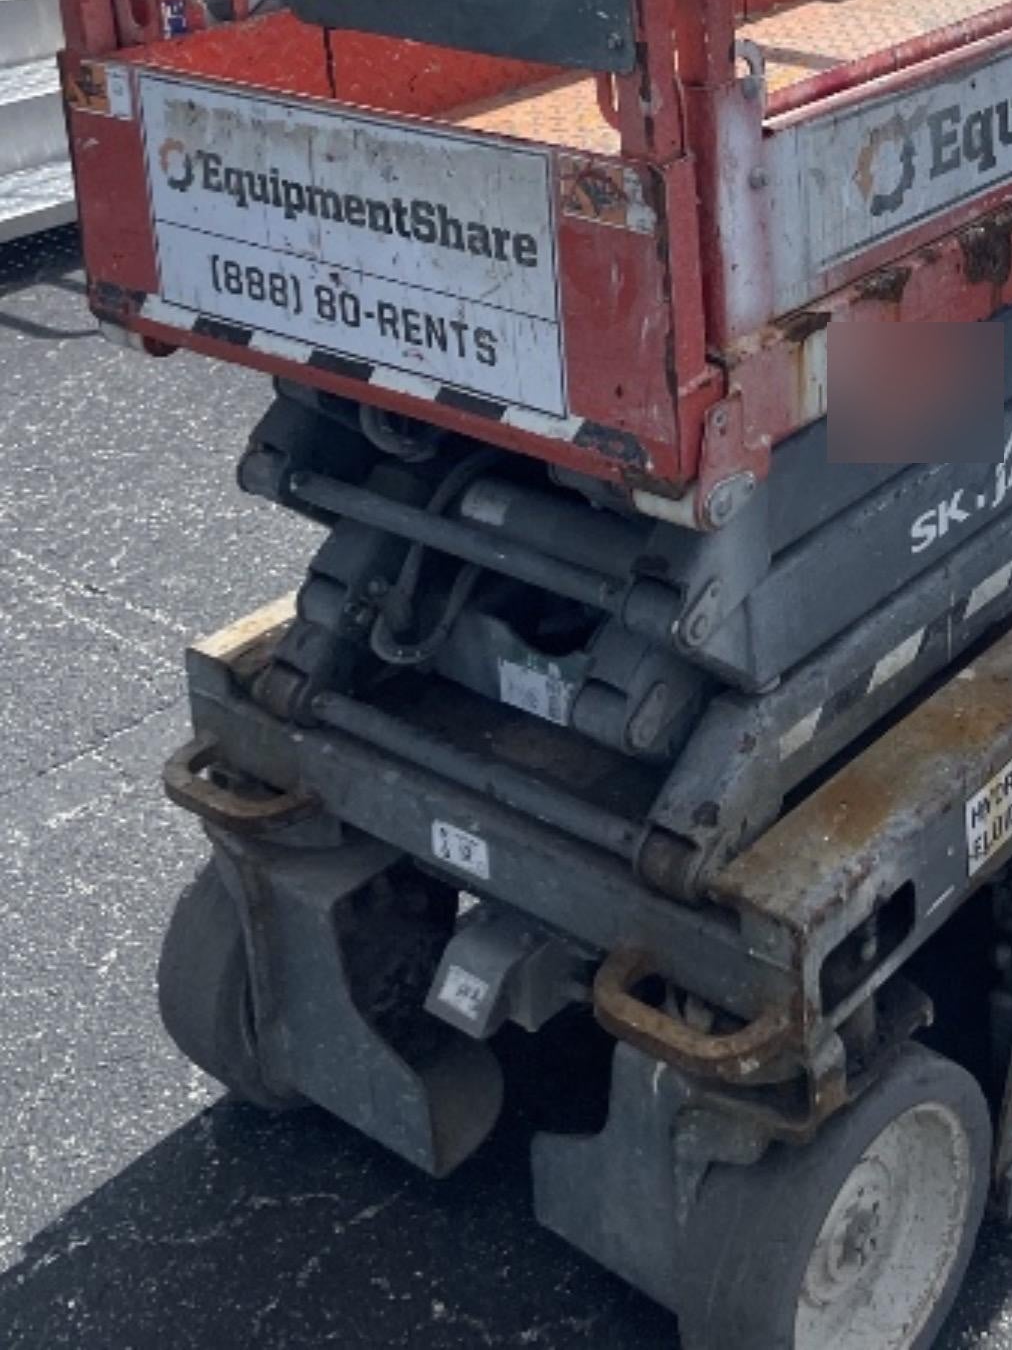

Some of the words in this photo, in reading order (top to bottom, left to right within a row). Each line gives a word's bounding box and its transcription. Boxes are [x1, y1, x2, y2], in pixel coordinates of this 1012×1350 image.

[201, 151, 538, 267] EquipmentShare
[211, 255, 302, 315] (888)
[315, 284, 499, 368] 80-RENTS
